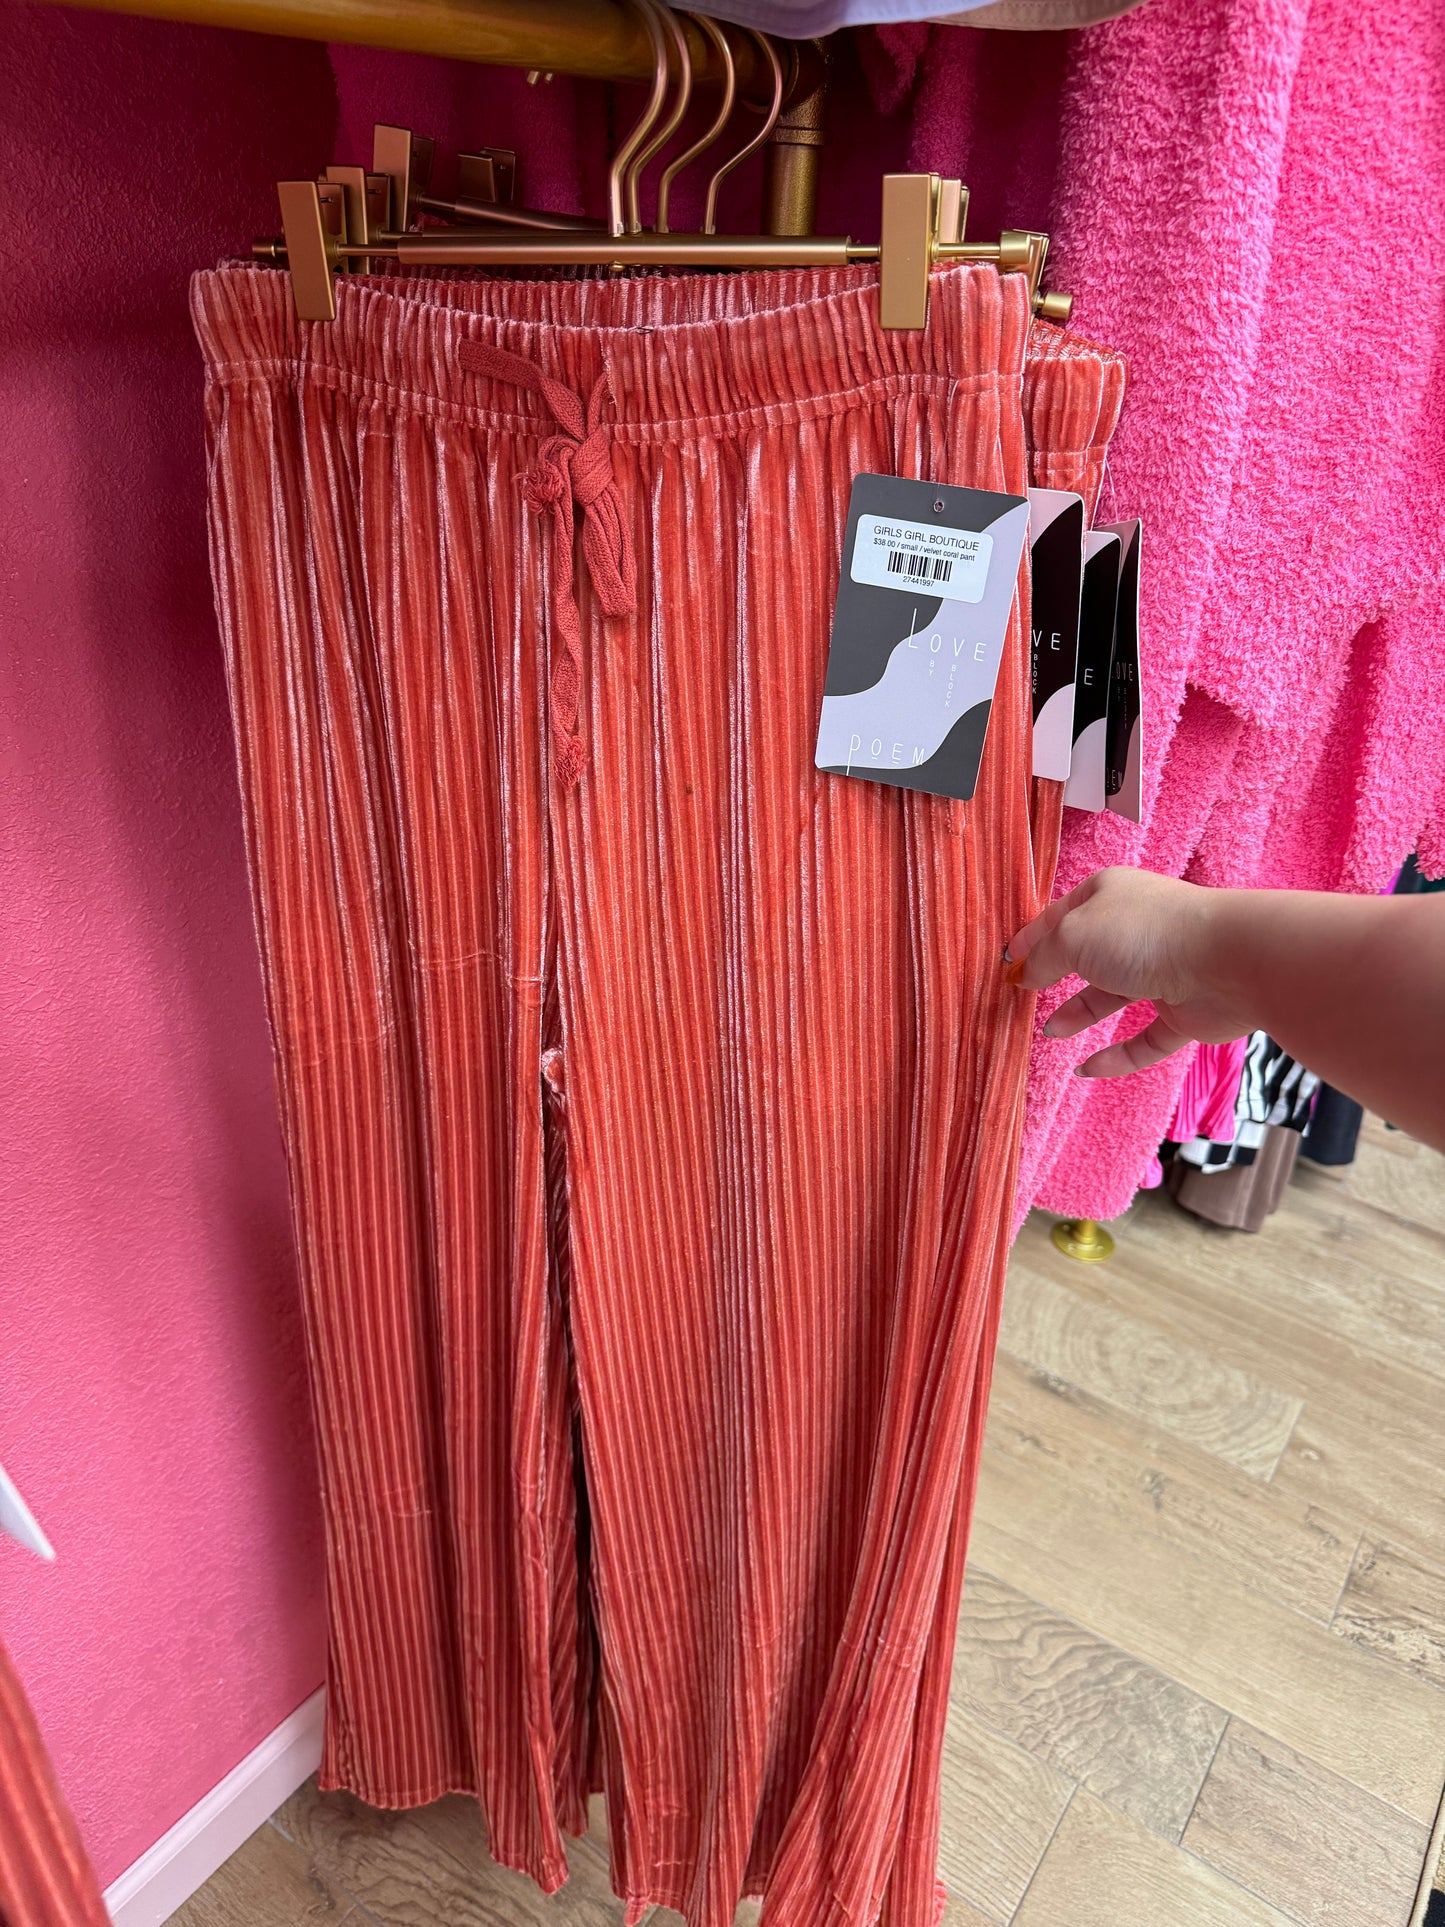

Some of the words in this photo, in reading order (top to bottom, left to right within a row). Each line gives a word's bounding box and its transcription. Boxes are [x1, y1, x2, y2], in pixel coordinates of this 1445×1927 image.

[873, 525, 902, 538] GIRLS
[904, 530, 927, 543] GIRL
[929, 534, 980, 551] BOUTIQUE
[873, 537, 896, 548] $38.00
[900, 543, 918, 552] small
[923, 546, 942, 556] velvet
[943, 549, 959, 559] coral
[959, 553, 975, 562] pant
[902, 575, 935, 587] 27441997
[908, 608, 987, 661] LOVE
[1032, 629, 1061, 651] VE
[929, 659, 935, 677] BY
[1115, 661, 1133, 681] OVE
[944, 664, 957, 708] BLOCK
[846, 734, 925, 776] POEM
